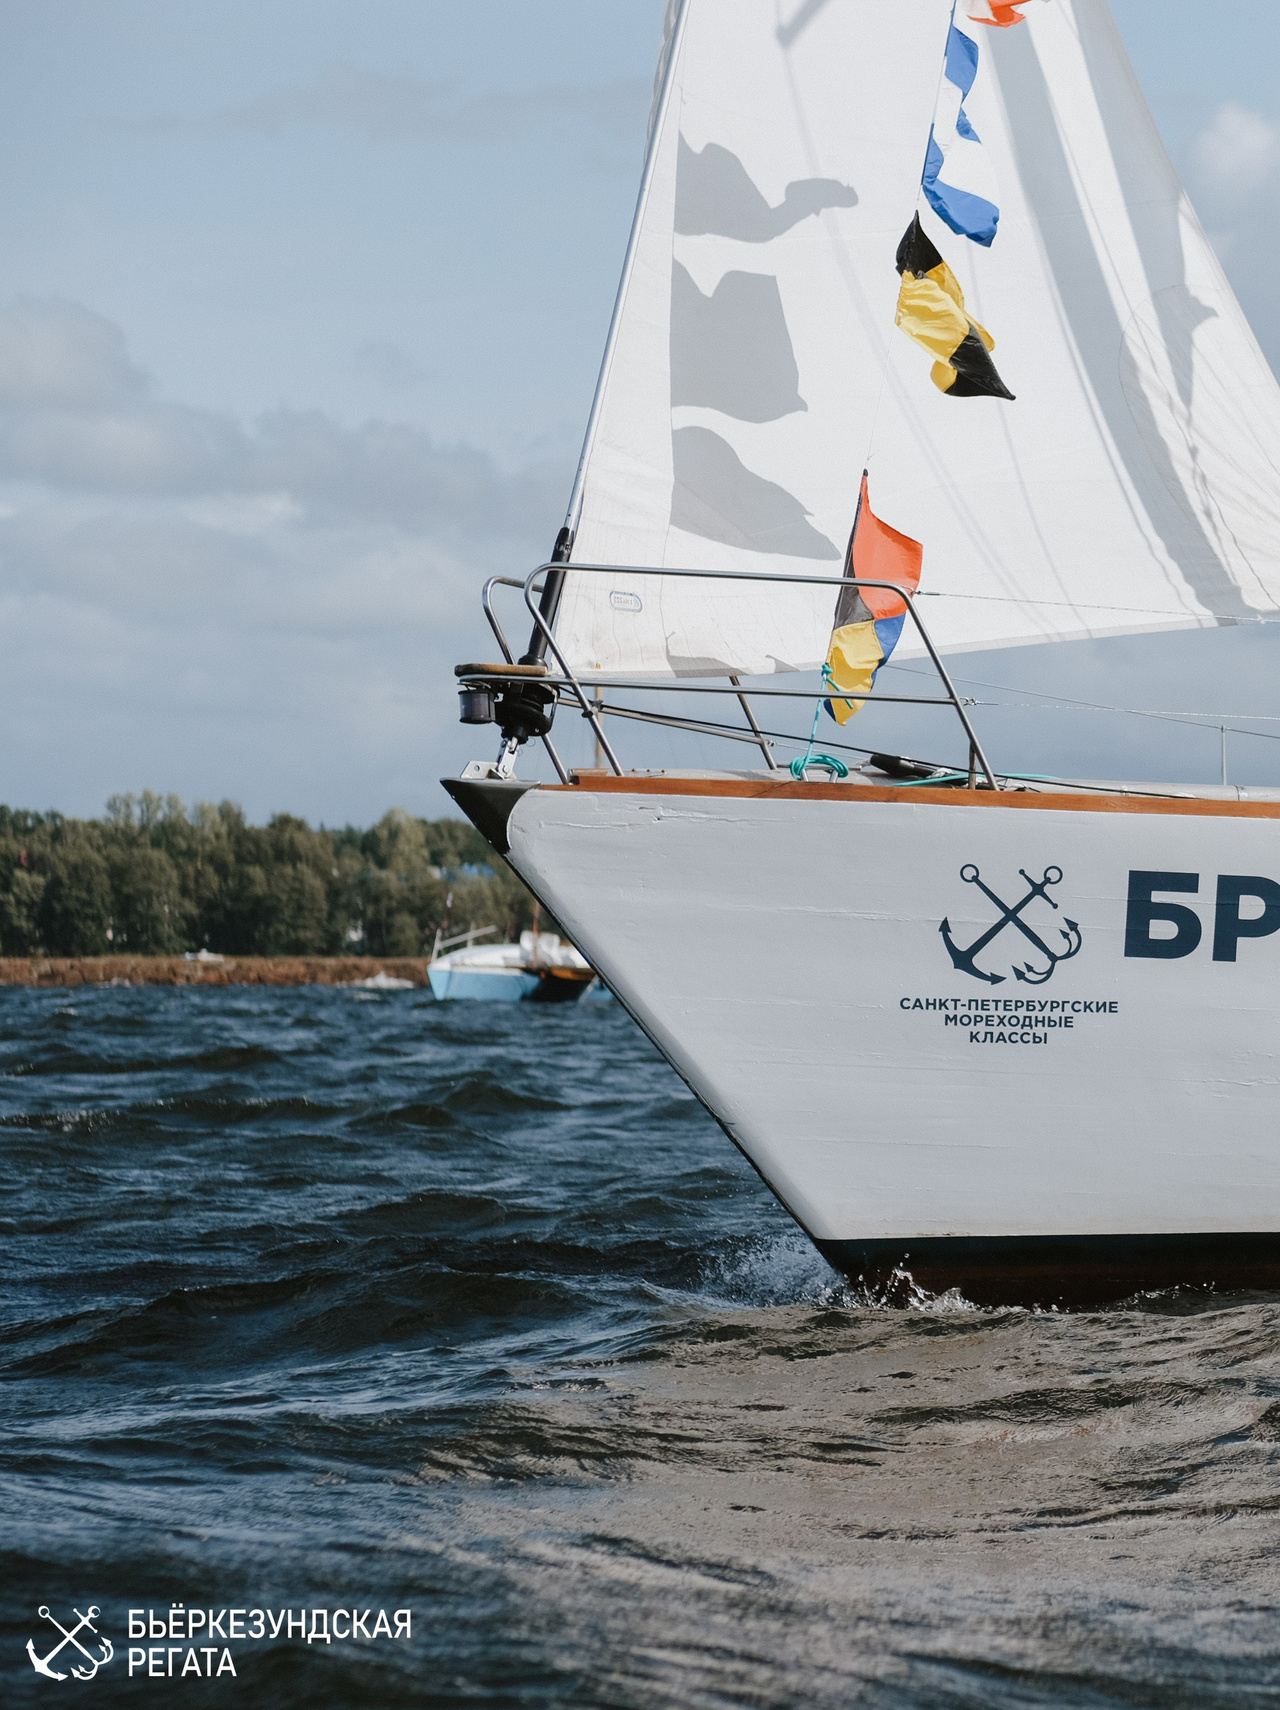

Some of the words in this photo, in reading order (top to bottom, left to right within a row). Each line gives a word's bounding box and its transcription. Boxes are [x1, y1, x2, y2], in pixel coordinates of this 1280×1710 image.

[899, 997, 1119, 1014] САНКТ-ПЕТЕРБУРГСКИЕ
[944, 1014, 1074, 1030] МОРЕХОДНЫЕ
[969, 1031, 1048, 1045] КЛАССЫ
